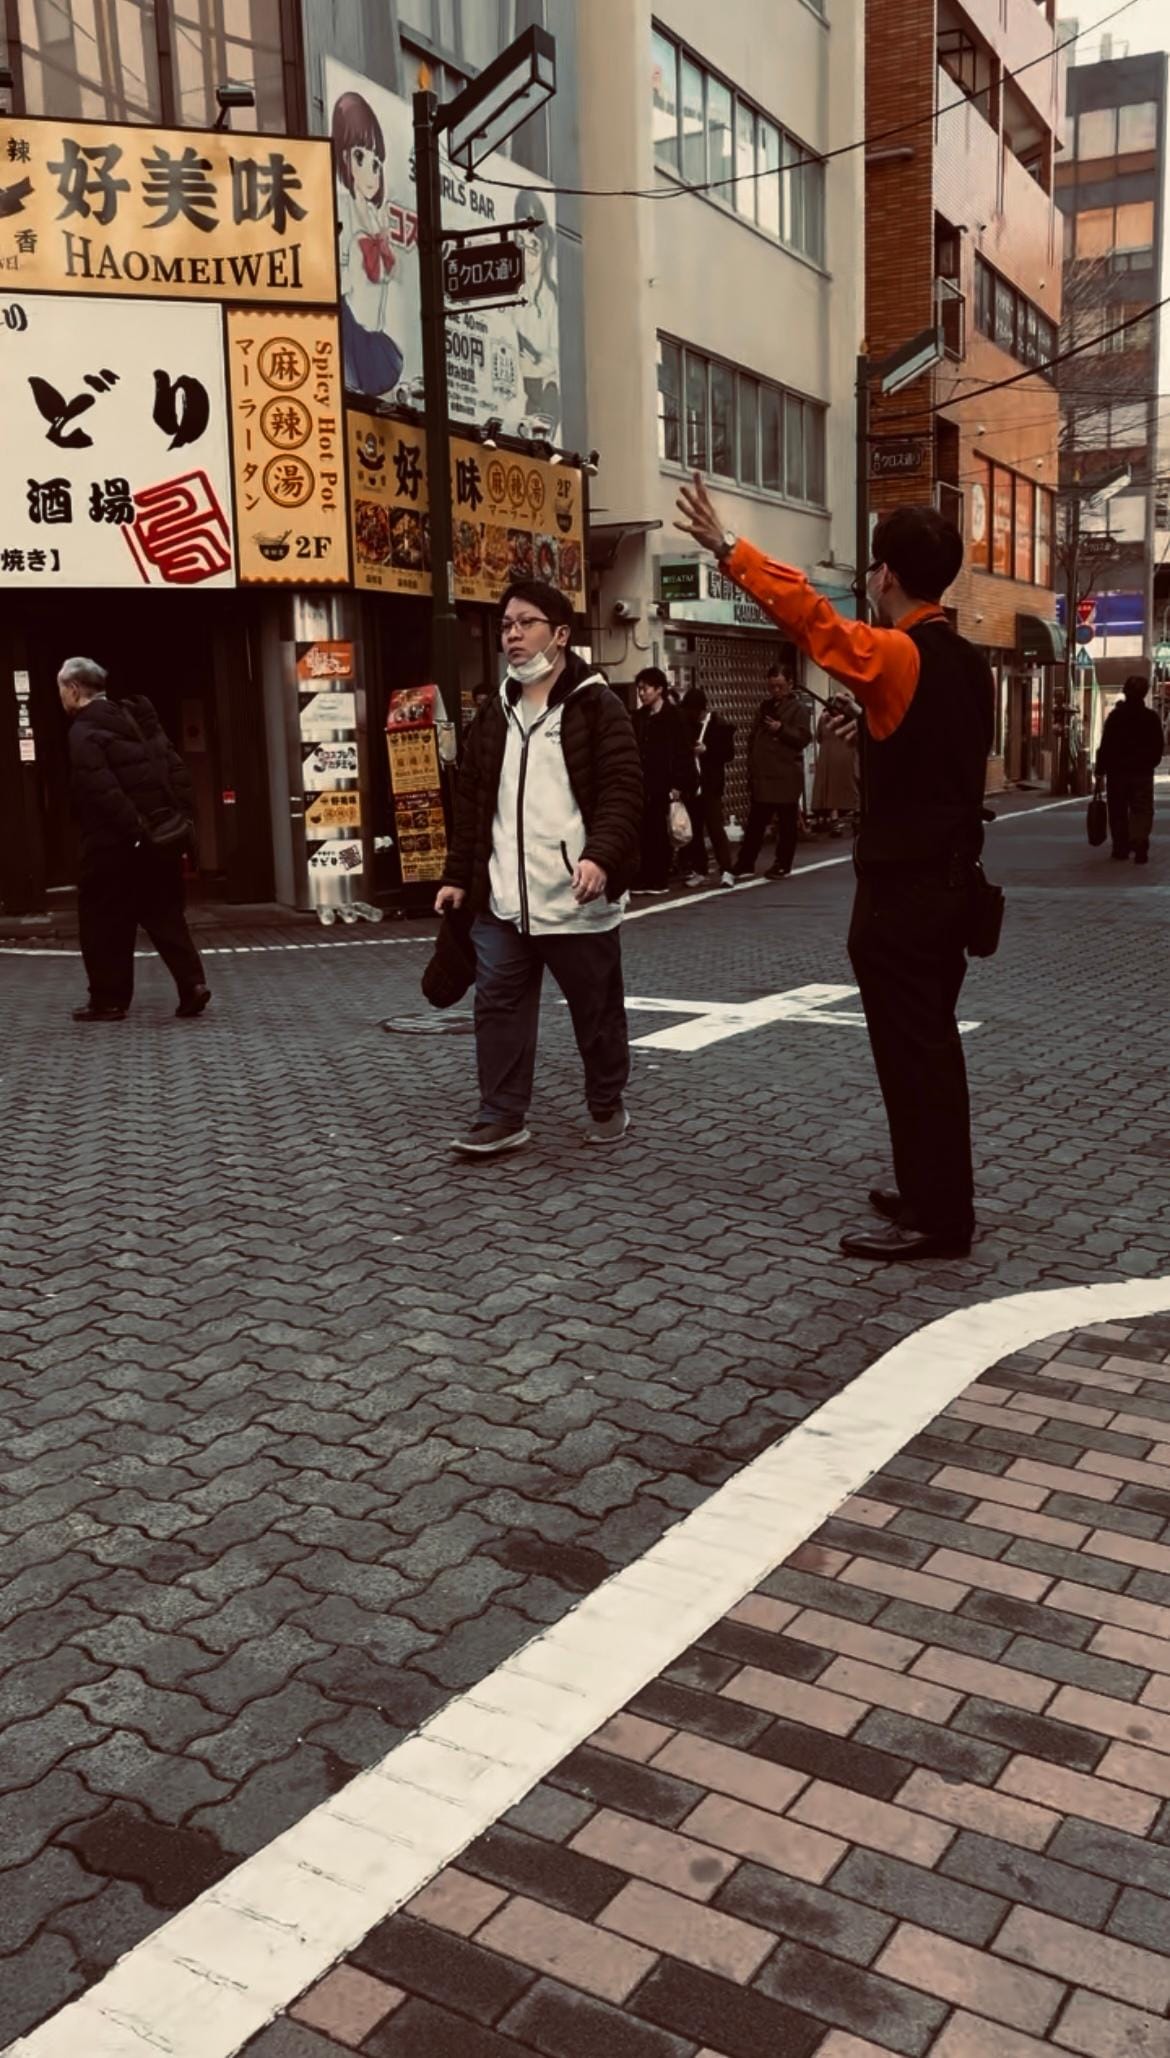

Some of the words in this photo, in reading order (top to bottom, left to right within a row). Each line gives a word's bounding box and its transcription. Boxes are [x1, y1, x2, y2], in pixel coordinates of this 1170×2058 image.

[47, 138, 308, 235] 好美味
[469, 189, 495, 221] BAR
[14, 229, 38, 255] 香
[62, 230, 304, 289] HAOMEIWEI
[459, 257, 520, 286] クロス通り
[311, 341, 334, 408] Spicy
[235, 338, 260, 511] マーラータン
[268, 347, 305, 498] 麻辣湯
[317, 417, 336, 462] Hot
[27, 477, 135, 525] 酒場
[319, 471, 338, 513] Pot
[557, 478, 572, 498] 2F
[295, 536, 332, 560] 2F
